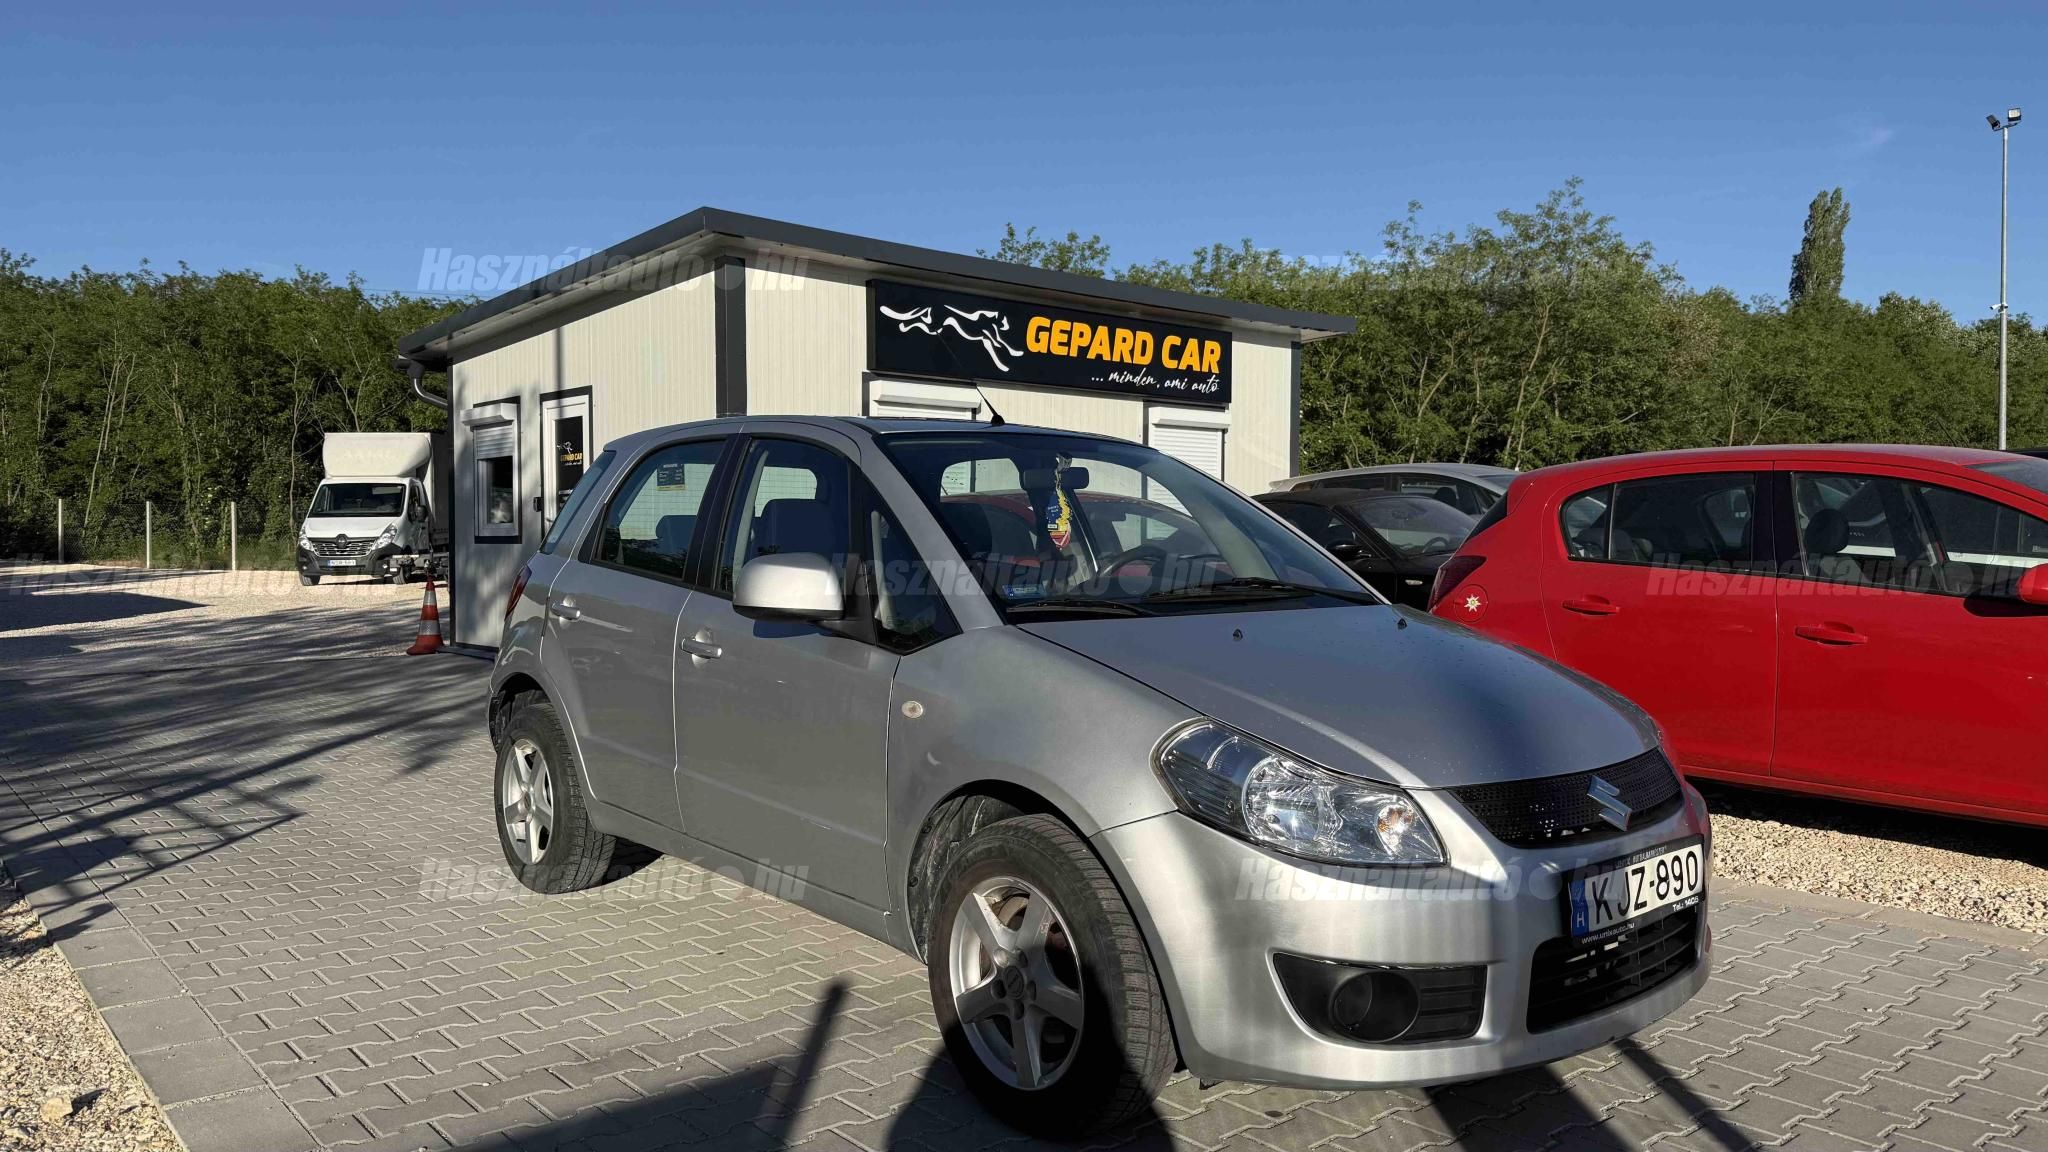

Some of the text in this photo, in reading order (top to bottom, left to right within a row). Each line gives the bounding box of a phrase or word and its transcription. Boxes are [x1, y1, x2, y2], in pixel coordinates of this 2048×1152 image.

[1026, 316, 1221, 374] GEPARD CAR
[1108, 367, 1160, 388] minden,
[1164, 378, 1188, 390] ami
[1592, 850, 1699, 925] KJZ-890
[1576, 912, 1585, 928] H
